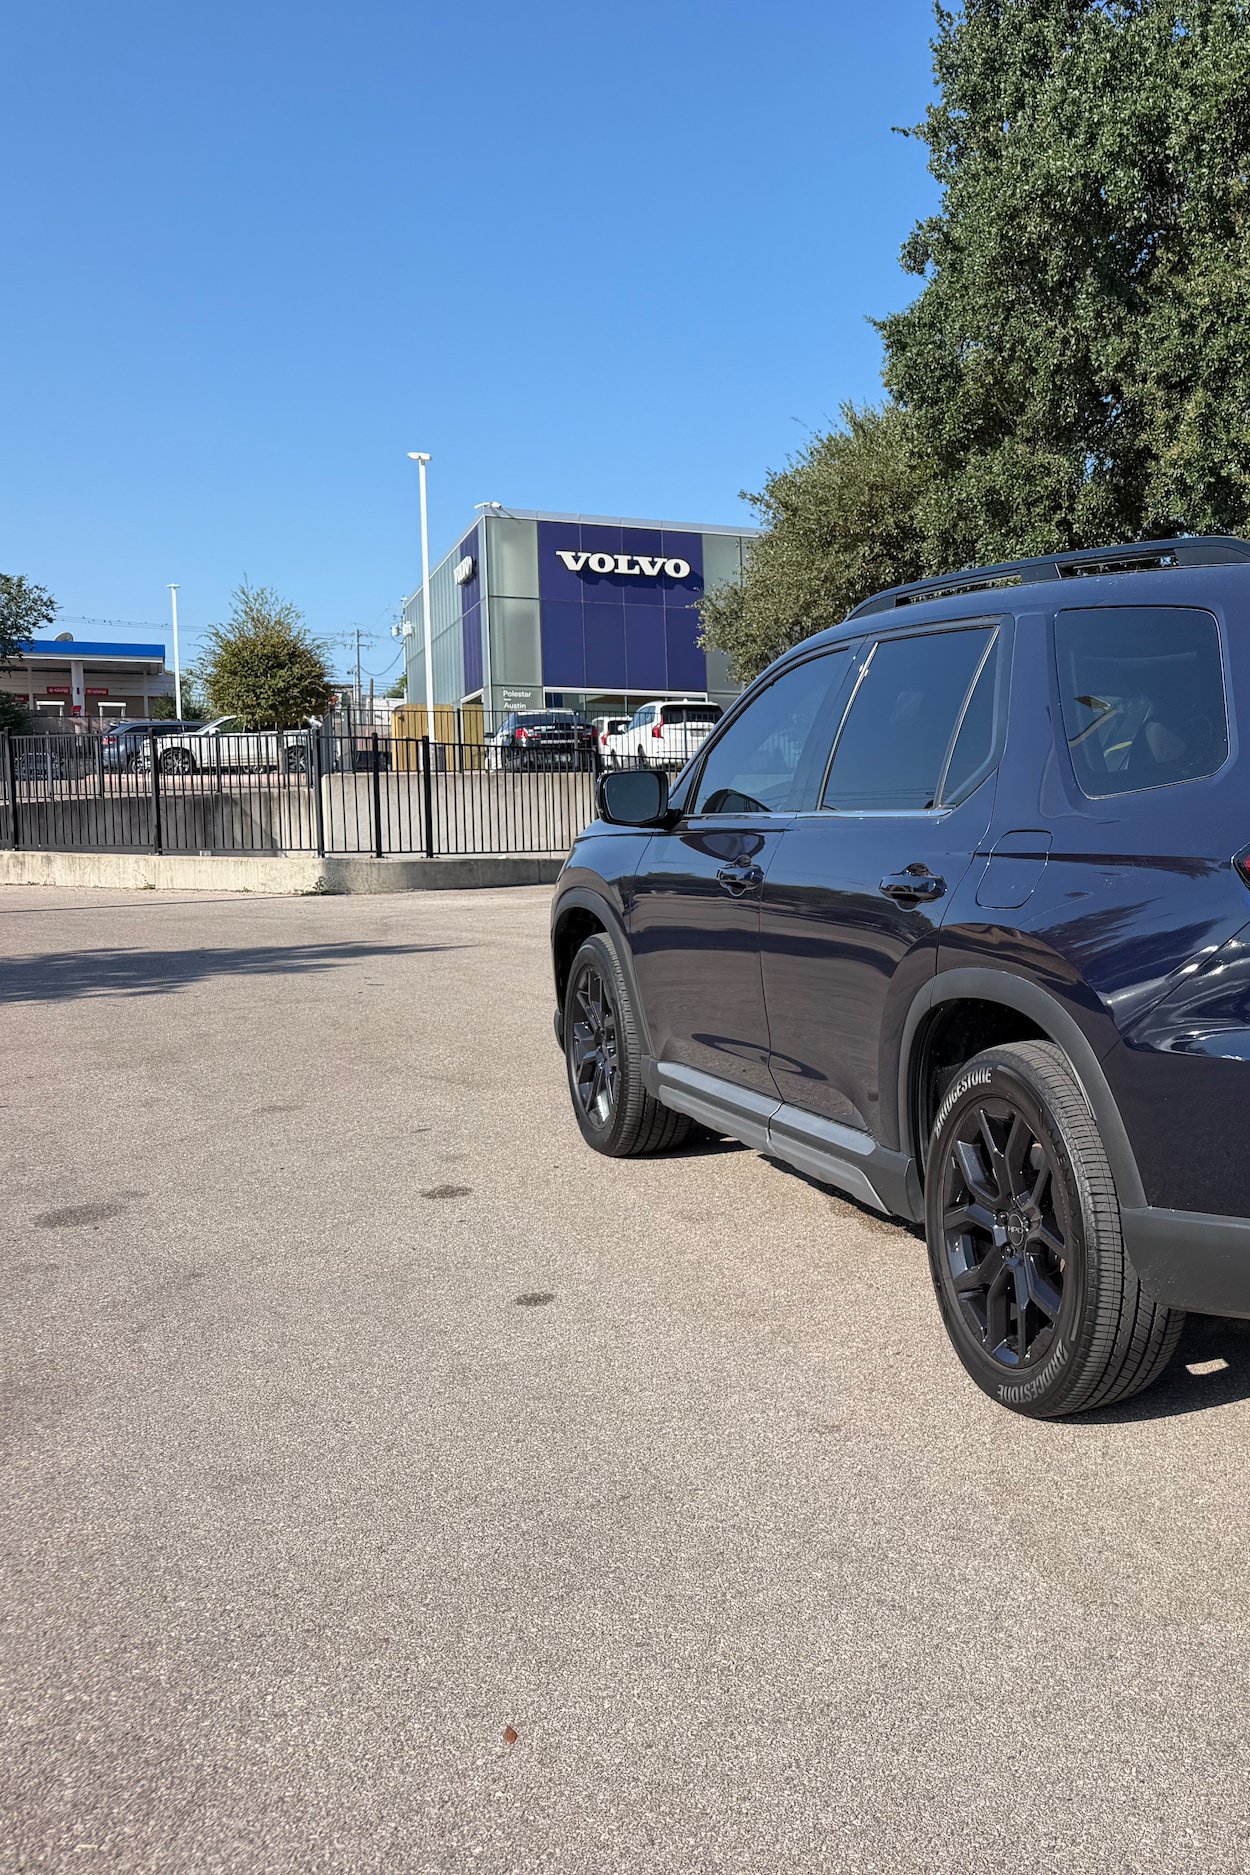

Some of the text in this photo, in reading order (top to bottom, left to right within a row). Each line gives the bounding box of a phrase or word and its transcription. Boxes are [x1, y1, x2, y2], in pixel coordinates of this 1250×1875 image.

[556, 551, 691, 579] VOLVO
[503, 690, 532, 698] Polestar
[935, 1066, 993, 1140] BRIDGESTONE
[997, 1338, 1069, 1404] BRIDGESTONE
